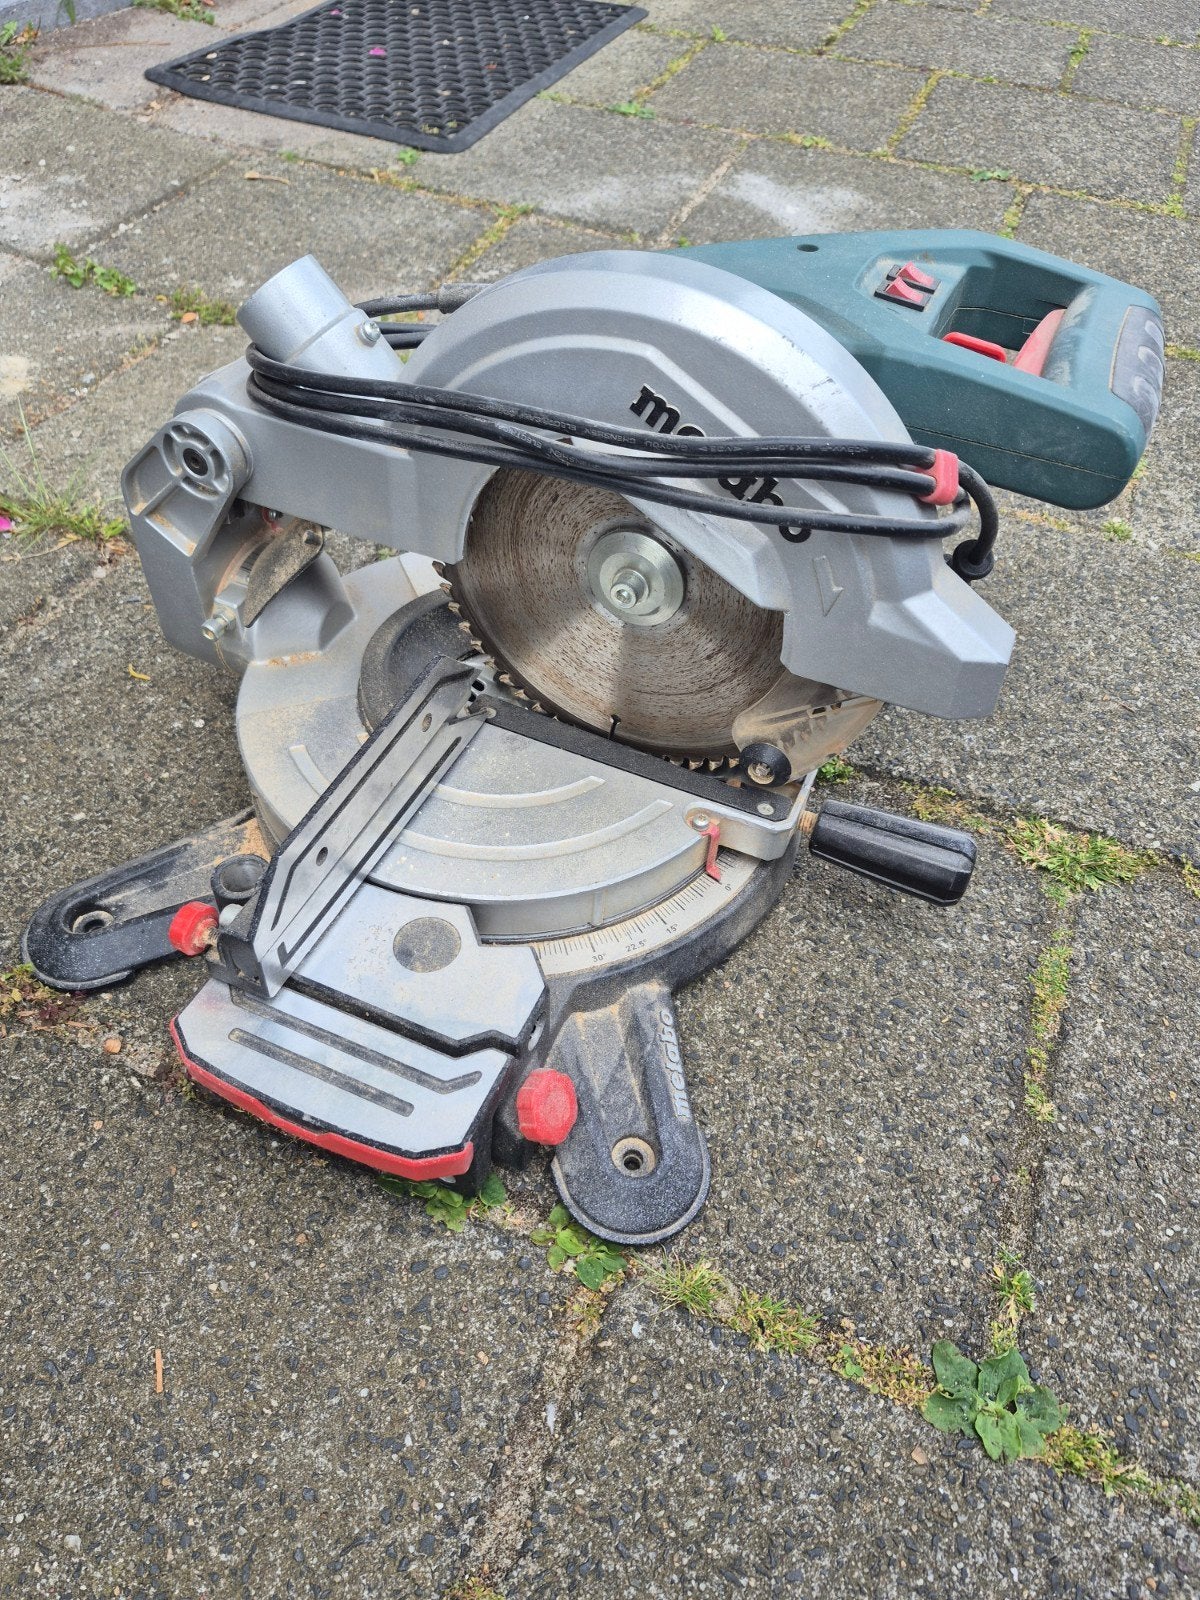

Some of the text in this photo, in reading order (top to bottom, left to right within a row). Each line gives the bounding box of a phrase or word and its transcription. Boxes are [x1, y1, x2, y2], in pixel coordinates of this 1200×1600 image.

[625, 938, 648, 953] 22.5°
[592, 952, 607, 963] 30°
[659, 1009, 692, 1119] metabo
